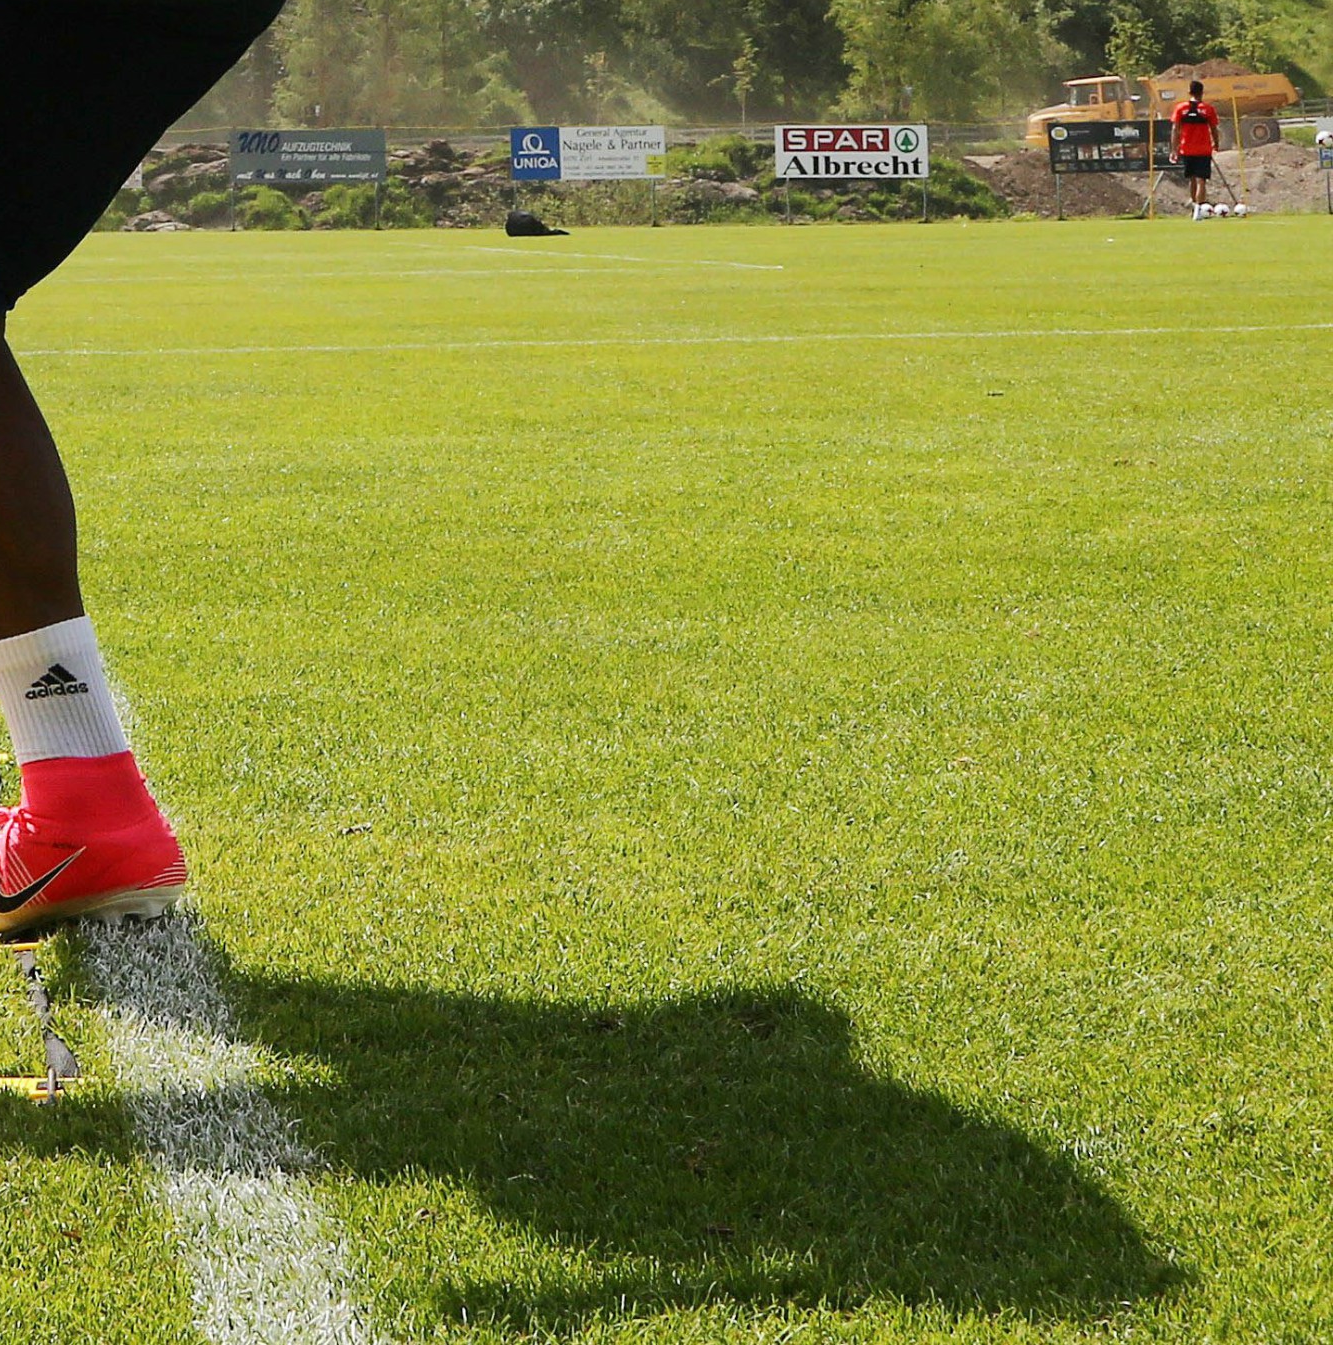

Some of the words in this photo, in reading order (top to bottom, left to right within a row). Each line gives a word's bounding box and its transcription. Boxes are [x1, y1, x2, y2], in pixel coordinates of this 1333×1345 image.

[562, 140, 602, 153] Nagele
[607, 141, 616, 150] &
[621, 139, 662, 150] Partner
[786, 129, 884, 150] SPAR
[513, 156, 559, 169] UNIQA
[783, 156, 923, 175] Albrecht
[25, 681, 89, 700] adidas
